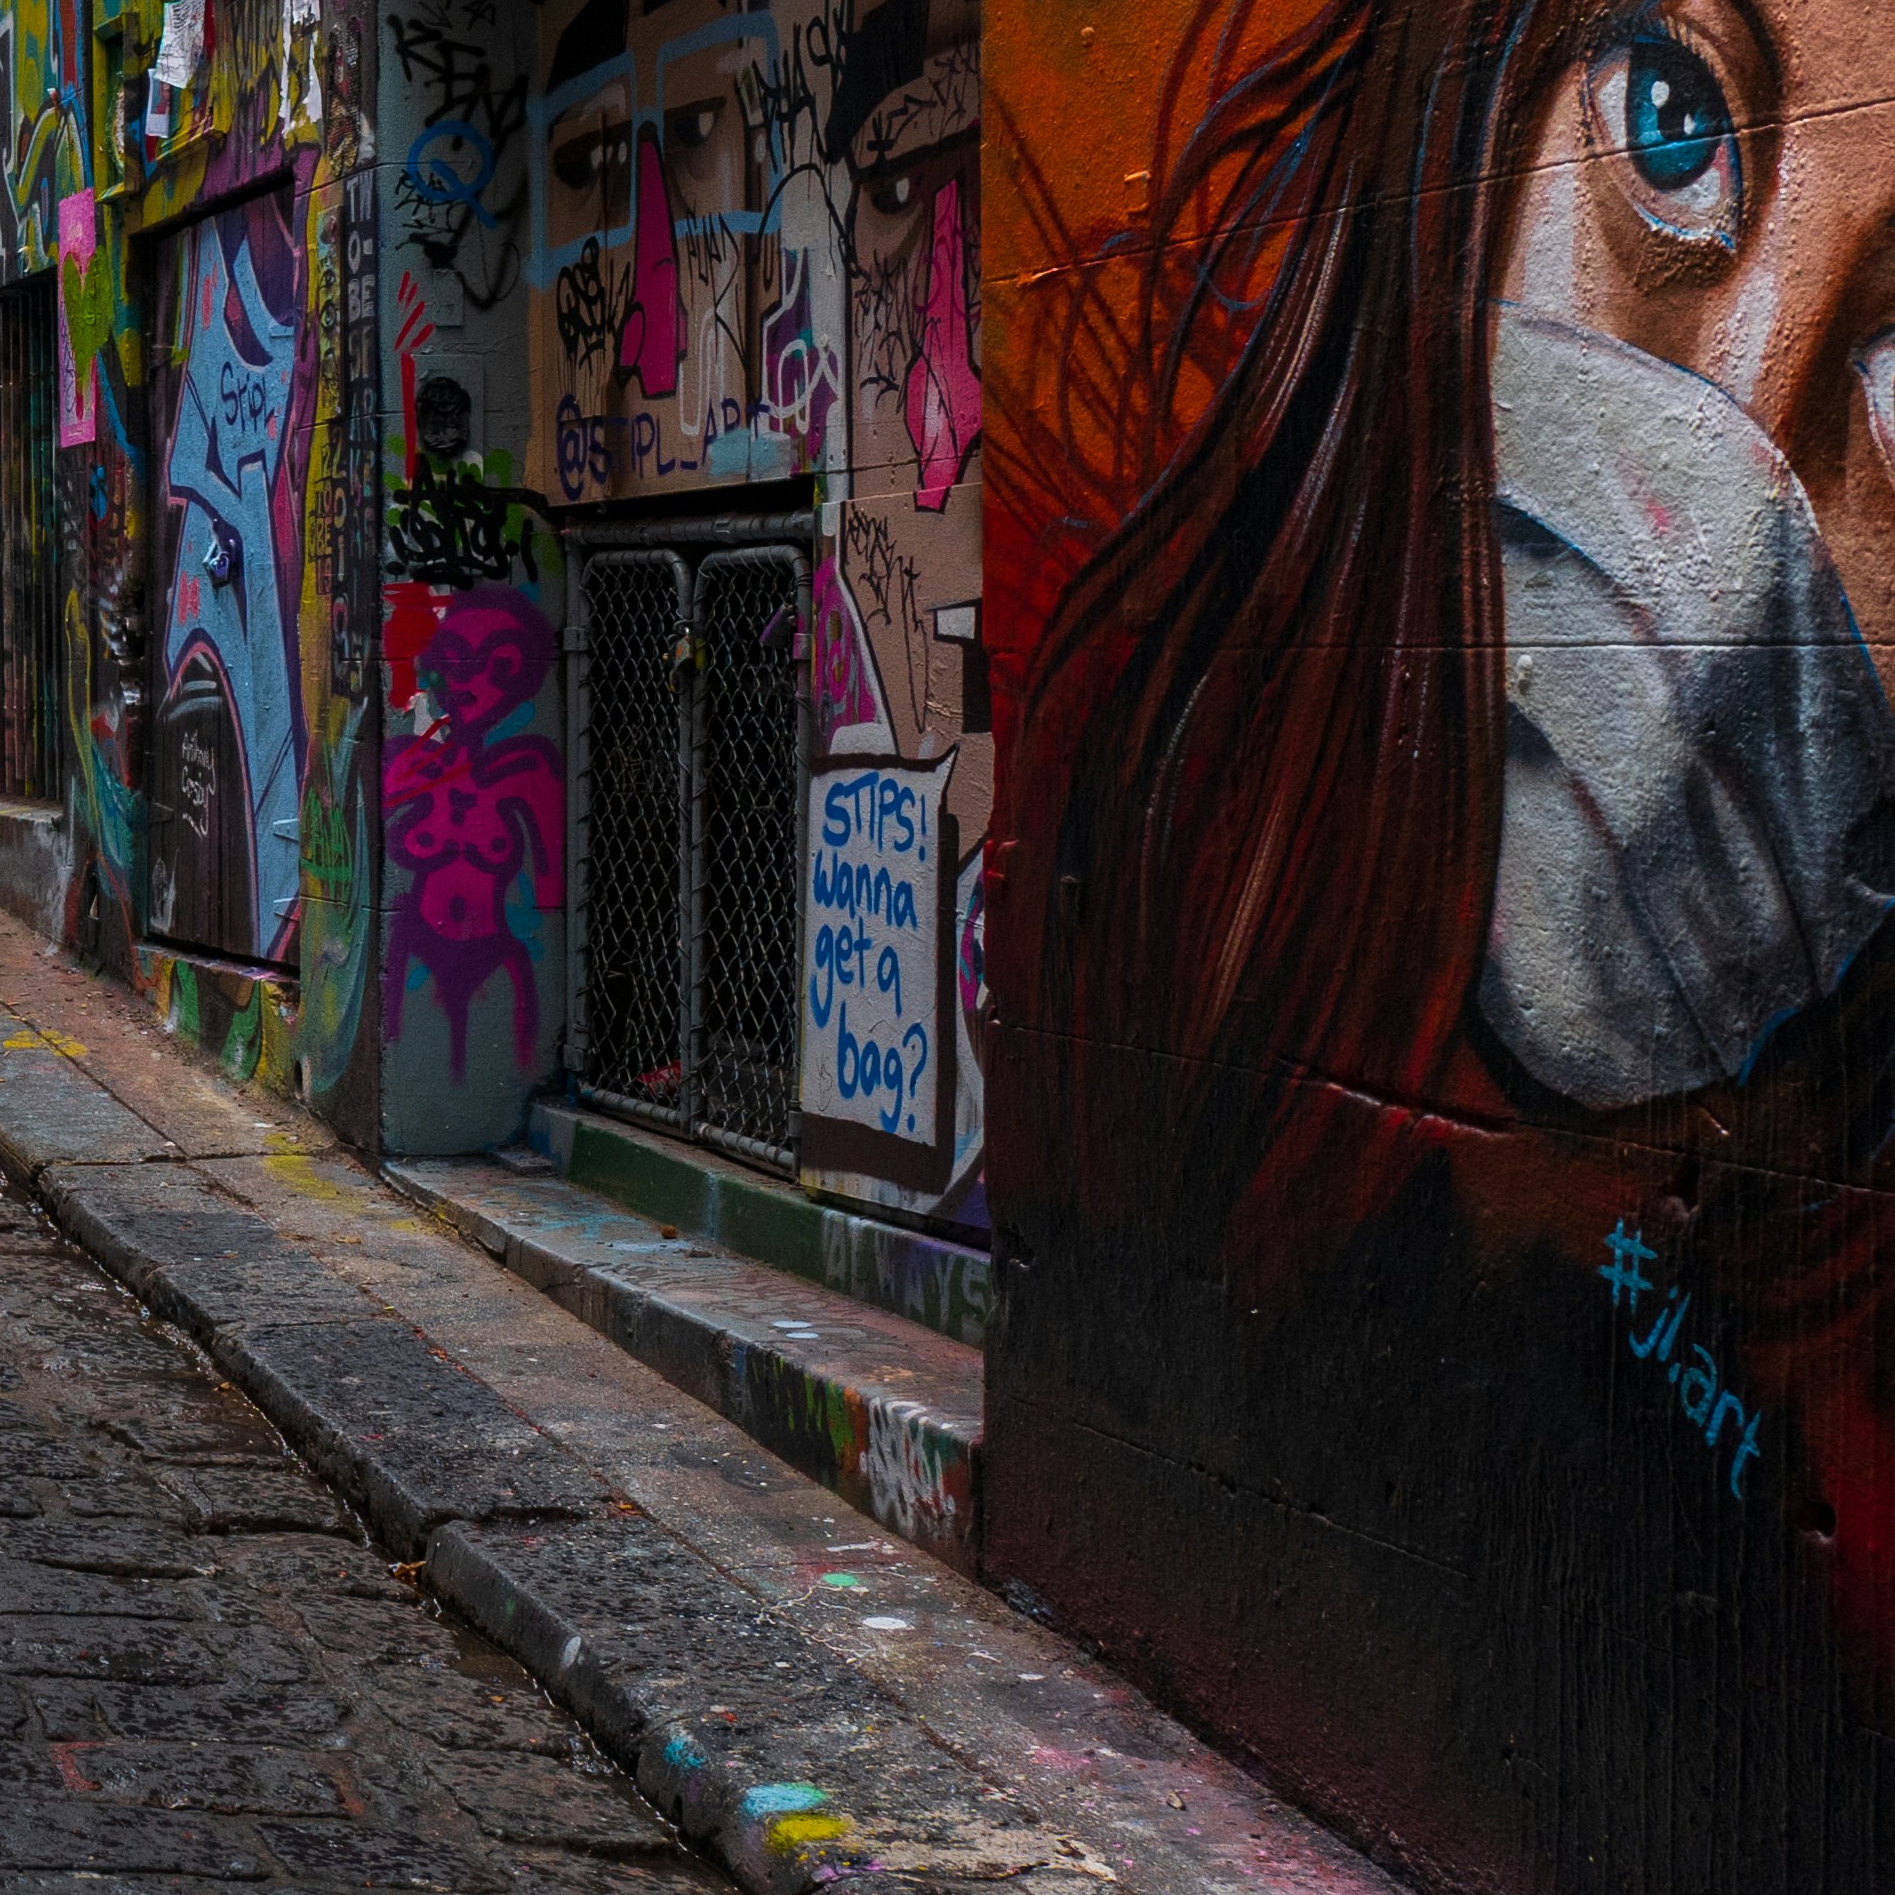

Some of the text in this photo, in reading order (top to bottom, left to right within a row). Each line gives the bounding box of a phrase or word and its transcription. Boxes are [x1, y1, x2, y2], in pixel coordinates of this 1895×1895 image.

[812, 919, 903, 1030] get a
[837, 1000, 929, 1134] bag?
